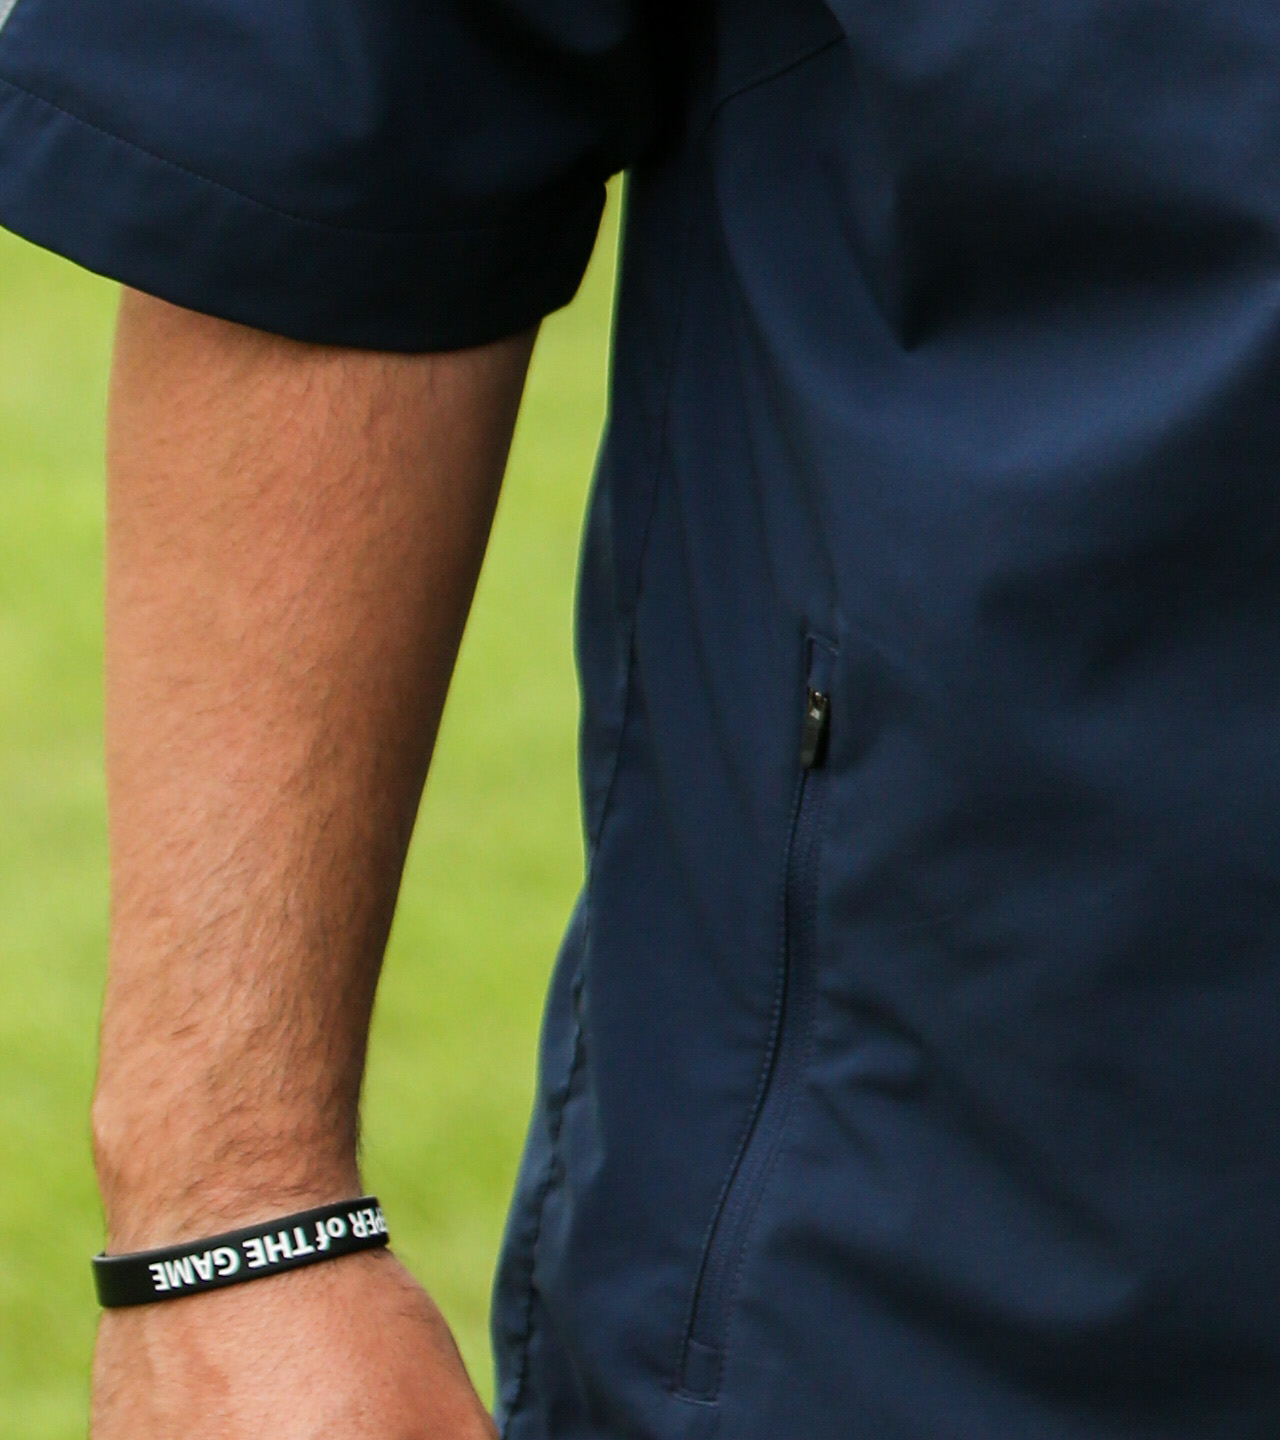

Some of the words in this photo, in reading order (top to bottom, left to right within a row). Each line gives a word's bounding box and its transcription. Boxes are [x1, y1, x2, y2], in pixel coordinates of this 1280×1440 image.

[242, 1226, 316, 1269] THE
[315, 1215, 348, 1252] of
[149, 1246, 240, 1292] GAME
